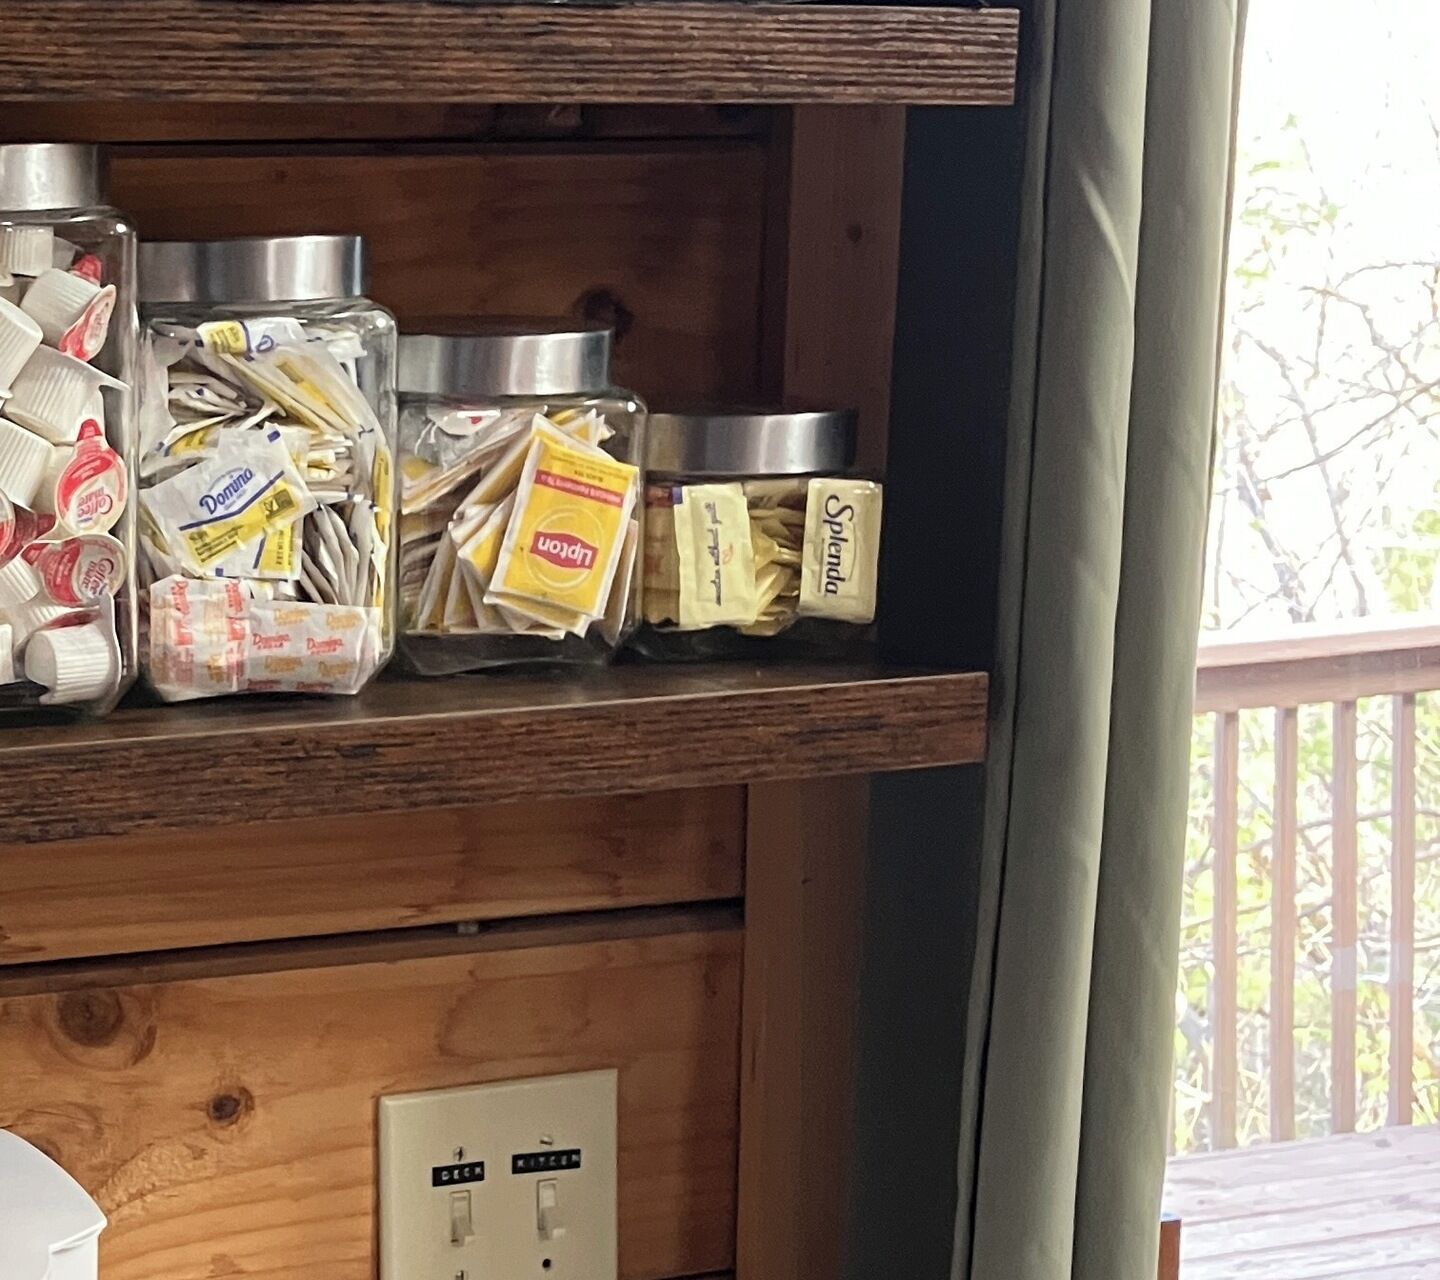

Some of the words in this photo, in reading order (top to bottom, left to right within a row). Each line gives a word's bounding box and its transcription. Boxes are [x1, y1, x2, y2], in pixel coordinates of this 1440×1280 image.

[199, 467, 254, 515] Domino
[537, 536, 593, 566] Lipton
[823, 493, 855, 596] Splenda
